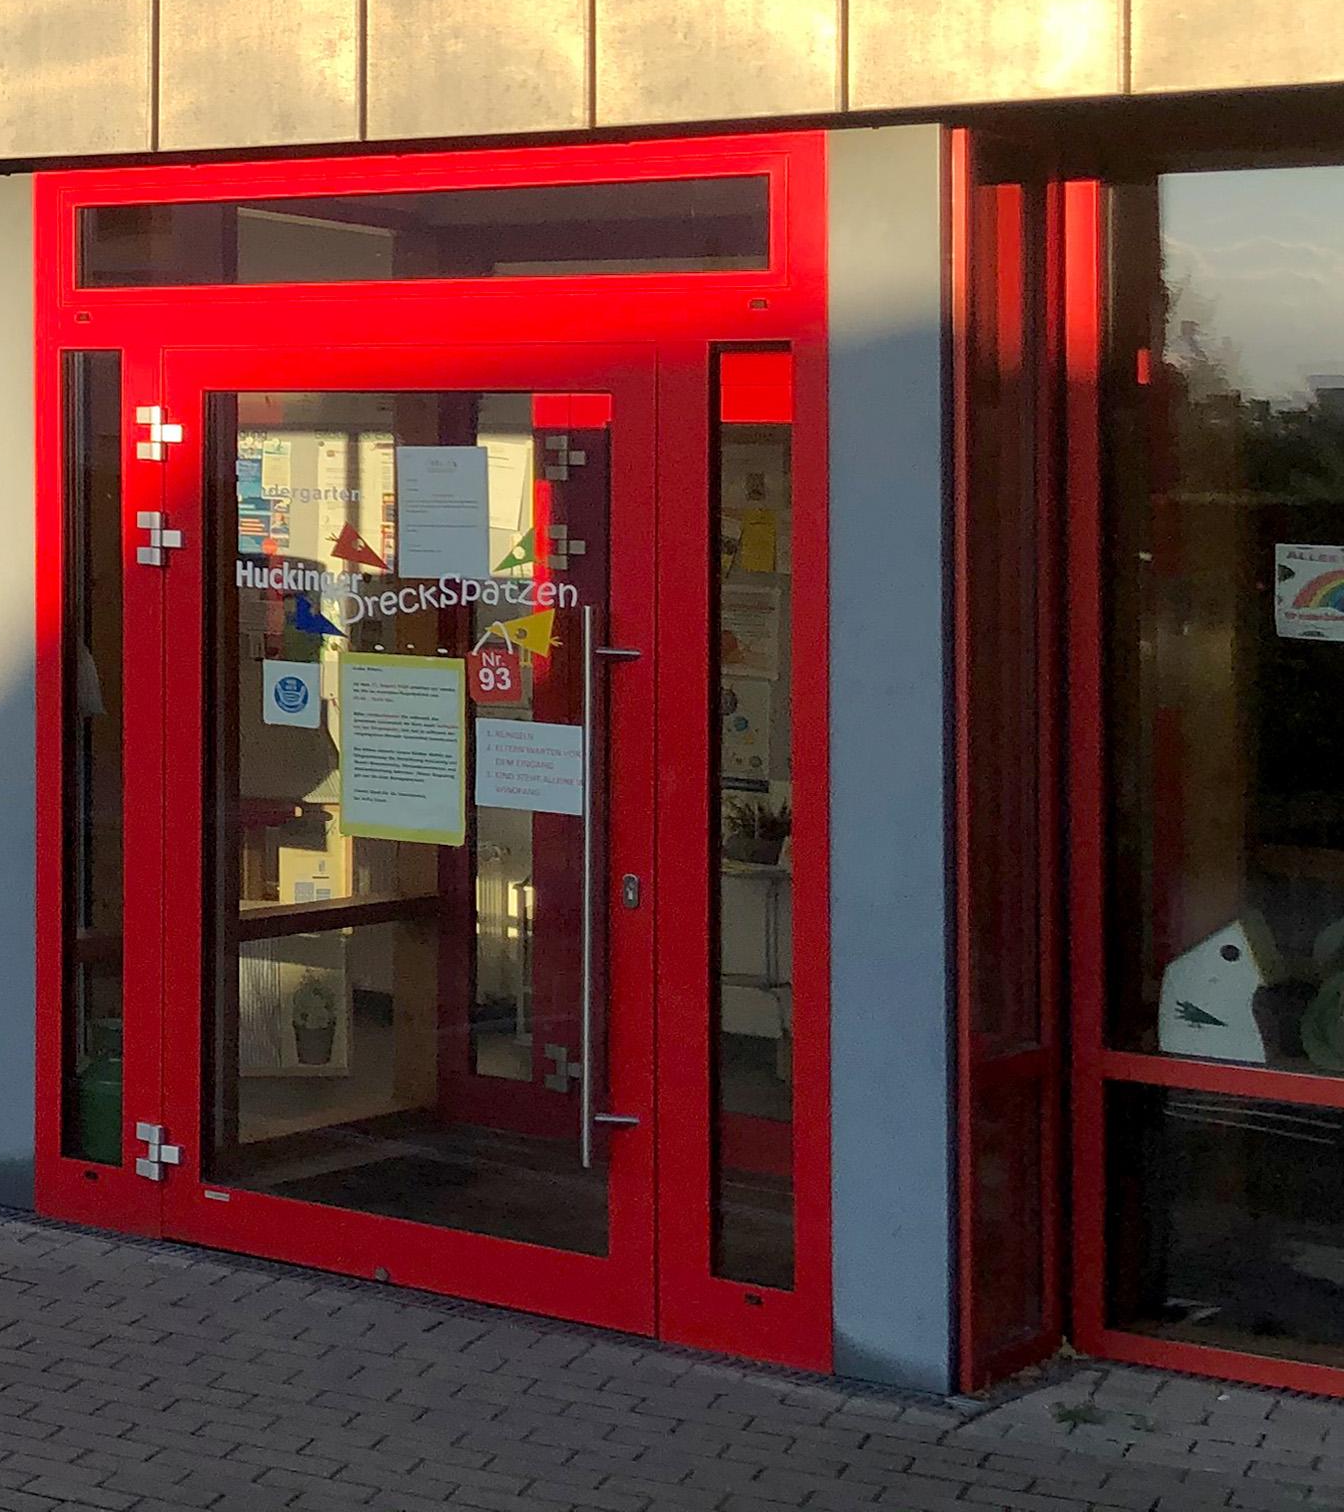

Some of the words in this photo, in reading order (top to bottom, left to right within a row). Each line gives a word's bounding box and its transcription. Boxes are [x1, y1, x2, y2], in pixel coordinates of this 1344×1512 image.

[236, 560, 363, 597] Huckinger
[482, 652, 505, 667] Nr.
[478, 667, 512, 691] 93
